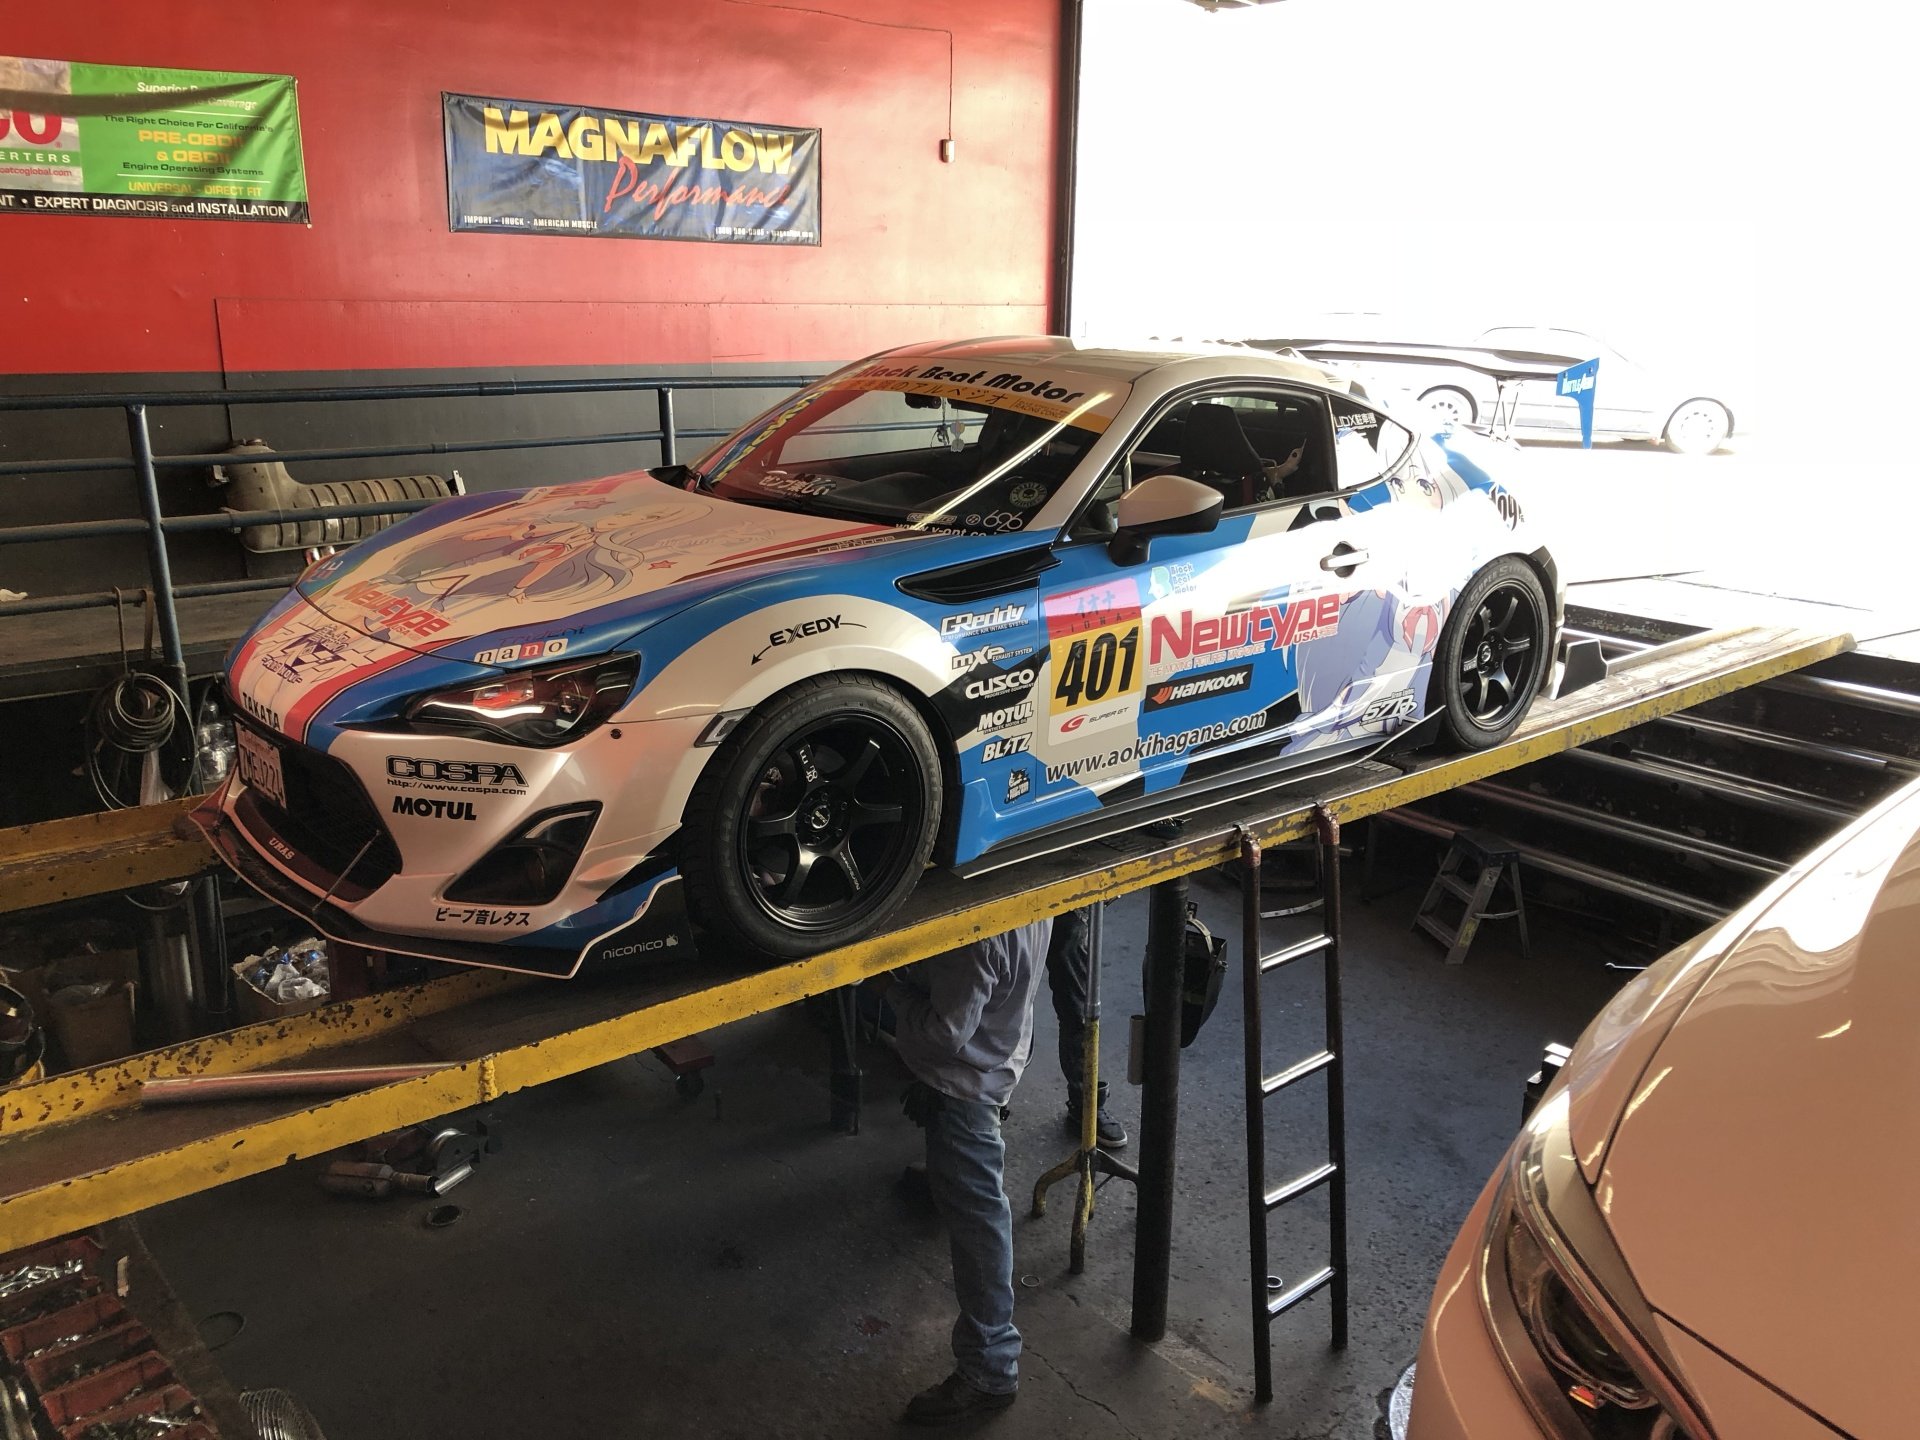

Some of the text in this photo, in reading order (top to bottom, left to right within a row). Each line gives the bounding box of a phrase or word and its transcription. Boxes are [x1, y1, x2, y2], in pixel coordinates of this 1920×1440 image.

[104, 114, 125, 124] The
[126, 116, 157, 127] Right
[158, 118, 195, 128] Choice
[196, 121, 214, 129] For
[483, 107, 795, 175] MAGNAFLOW
[123, 162, 264, 176] Engine Operating Systems
[128, 181, 263, 197] UNIVERSAL DIRECT FIT
[34, 196, 89, 210] EXPERT
[93, 198, 168, 212] DIAGNOSIS
[171, 201, 194, 213] and
[198, 203, 288, 217] INSTALLATION
[463, 215, 492, 225] IMPORT
[533, 218, 570, 228] AMERICAN
[571, 220, 598, 229] MUSCLE
[917, 366, 987, 384] Beat
[983, 372, 1086, 403] Motor
[331, 579, 452, 638] Newtype
[769, 614, 841, 648] EXEDY
[1149, 593, 1341, 666] Newtype
[1293, 631, 1318, 645] USA
[479, 641, 563, 662] nano
[1055, 626, 1139, 707] 401
[965, 668, 1035, 700] CUSCO
[242, 692, 281, 731] TAKATA
[977, 701, 1034, 732] MOTUL
[1046, 711, 1267, 783] www.aokihagane.com
[386, 755, 529, 788] COSPA
[386, 778, 527, 796] http://www.cospa.com
[392, 796, 477, 821] MOTUL
[268, 837, 295, 860] URAS
[602, 939, 664, 960] niconico
